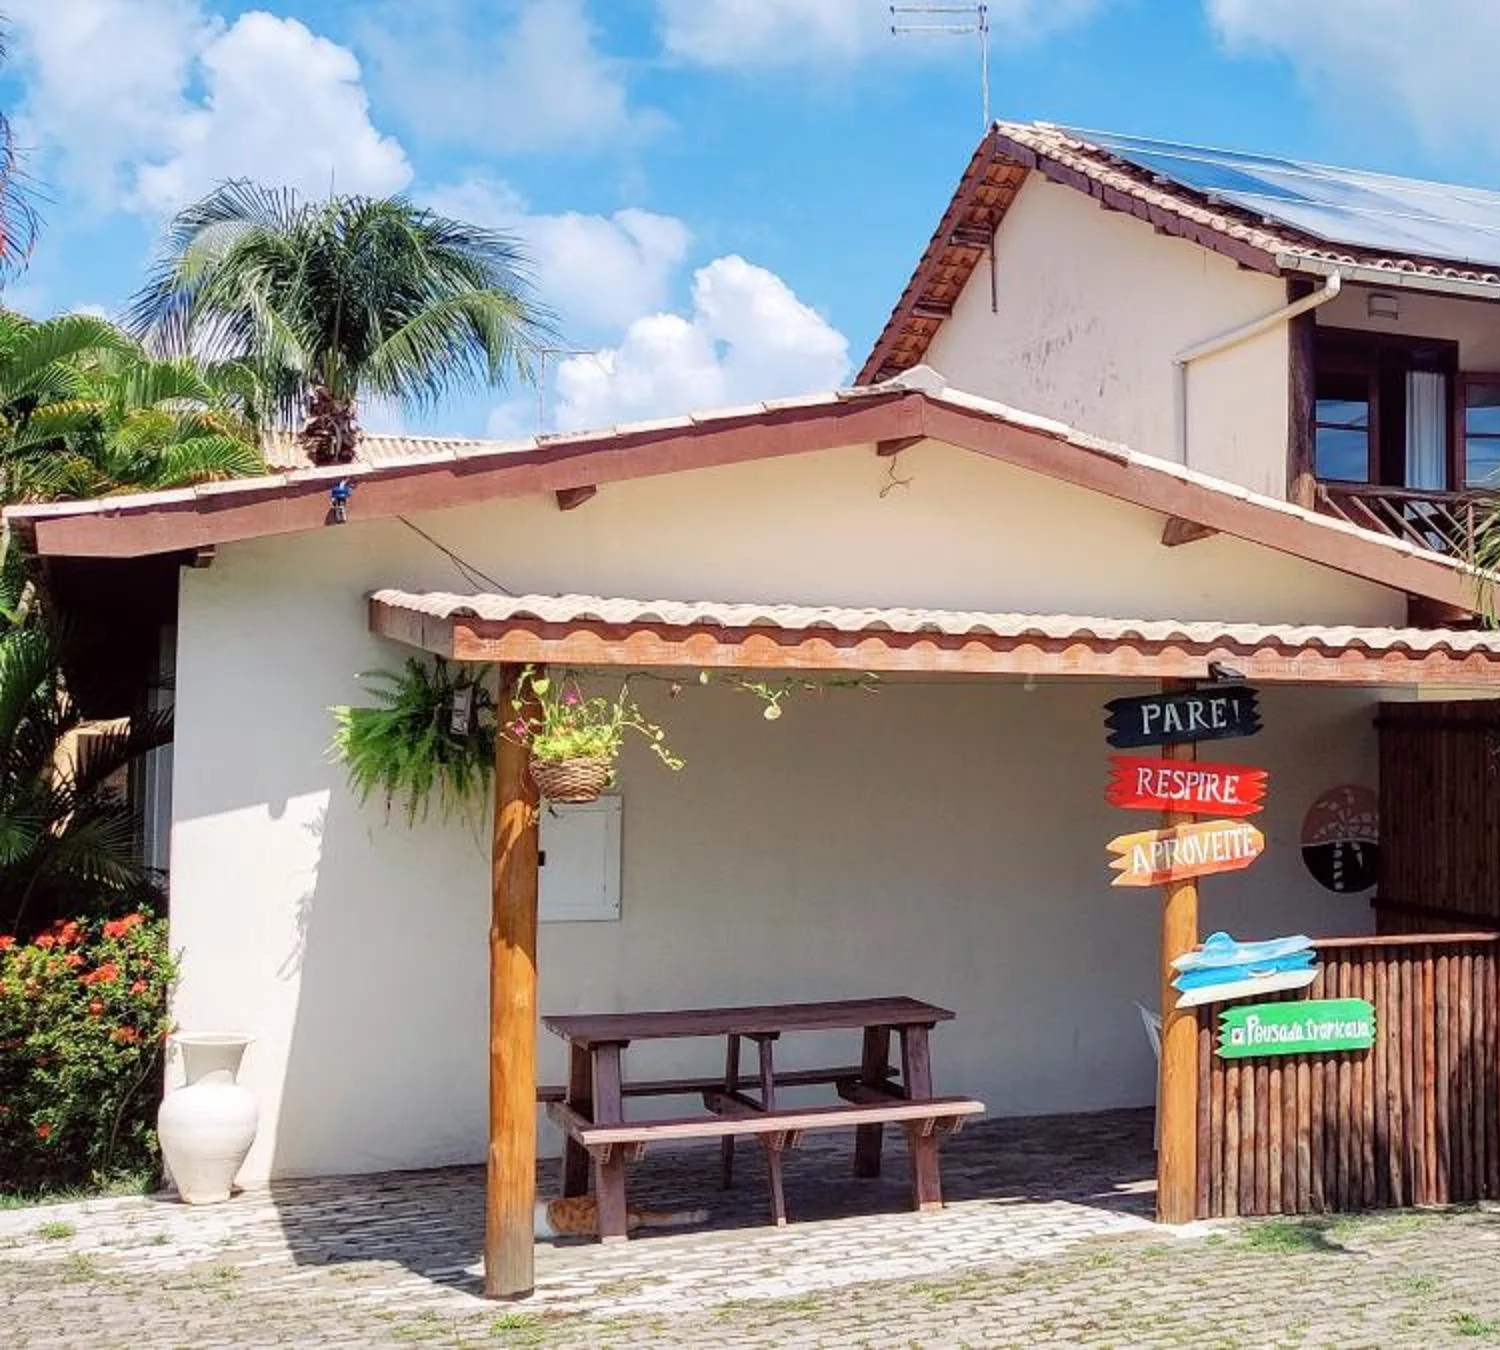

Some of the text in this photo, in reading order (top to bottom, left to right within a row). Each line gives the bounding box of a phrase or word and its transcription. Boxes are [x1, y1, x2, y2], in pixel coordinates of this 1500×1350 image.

[1141, 698, 1240, 735] PARE!
[1136, 767, 1240, 804] RESPIRE
[1132, 826, 1257, 874] APROVEITE
